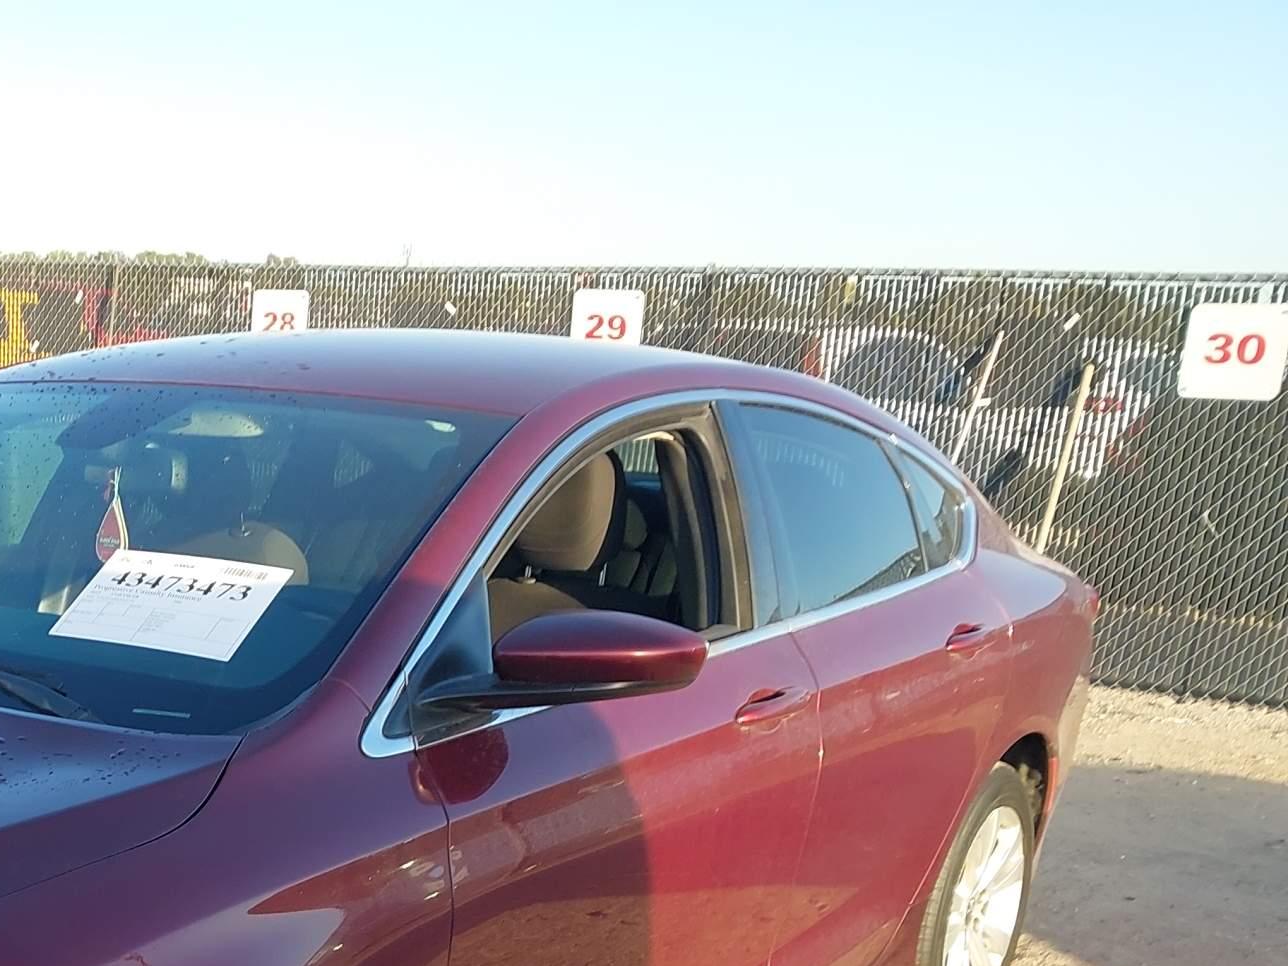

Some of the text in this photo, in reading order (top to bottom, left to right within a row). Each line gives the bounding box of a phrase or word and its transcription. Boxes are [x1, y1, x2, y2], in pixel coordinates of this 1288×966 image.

[263, 311, 294, 331] 28
[585, 314, 626, 340] 29
[1204, 333, 1266, 365] 30
[111, 570, 253, 602] 43473473
